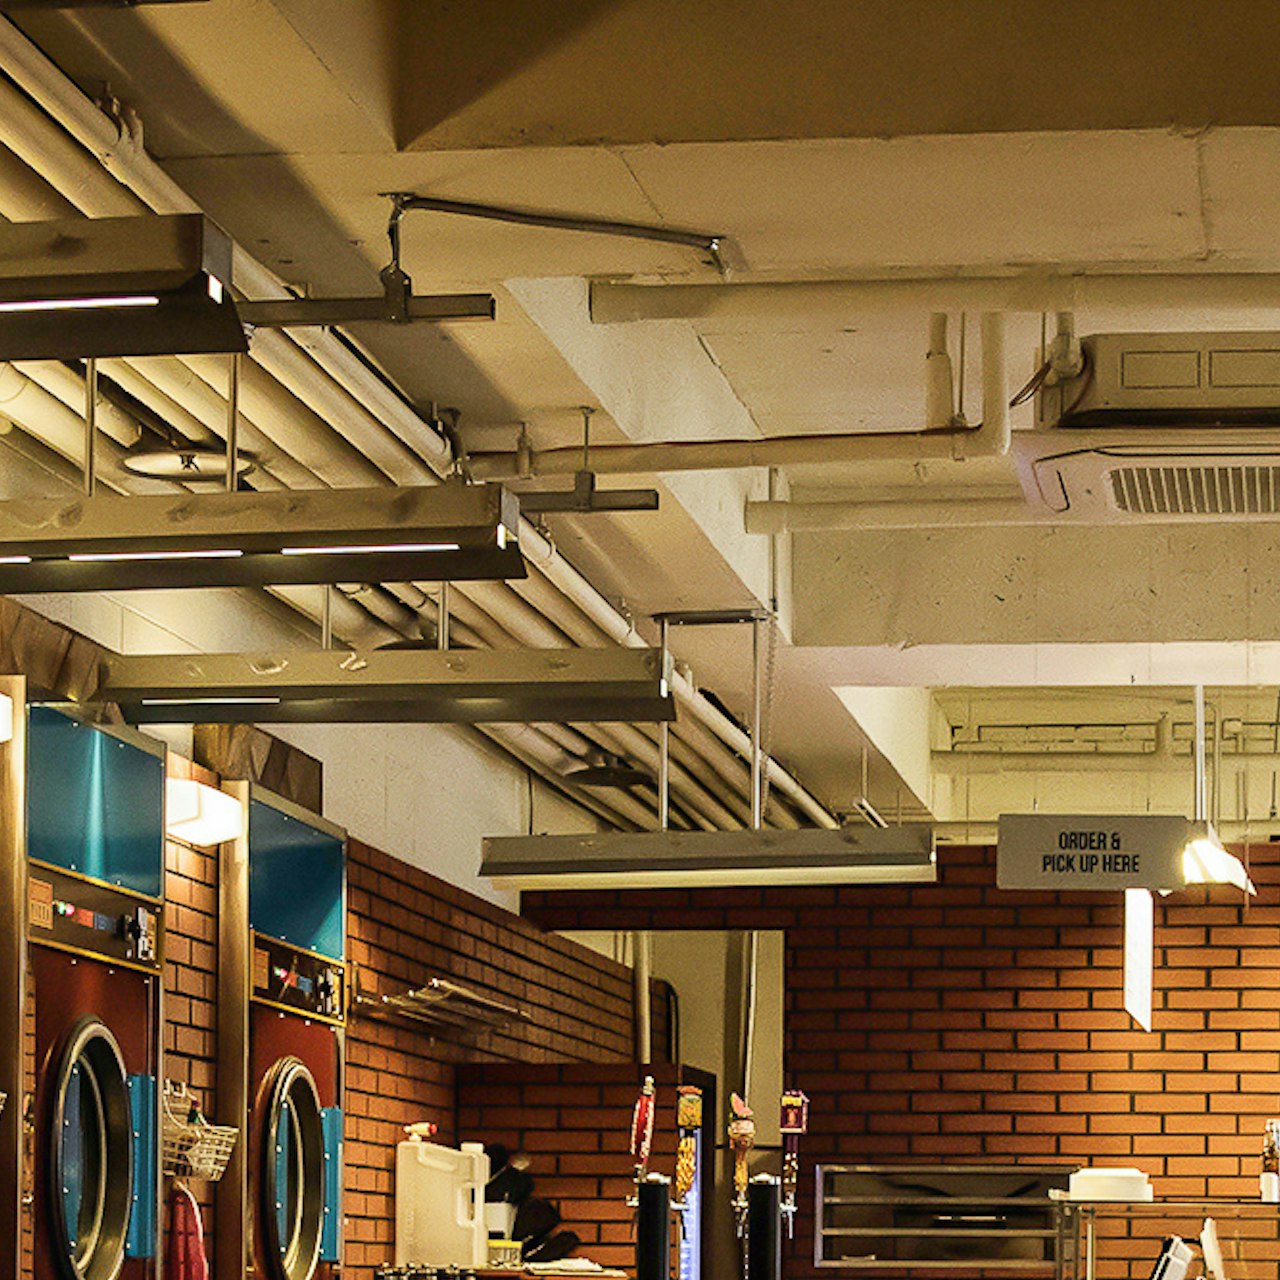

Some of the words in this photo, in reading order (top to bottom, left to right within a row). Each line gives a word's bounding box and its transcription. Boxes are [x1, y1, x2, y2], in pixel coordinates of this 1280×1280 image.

[1059, 832, 1107, 850] ORDER
[1111, 832, 1120, 850] &
[1042, 854, 1075, 872] PICK
[1080, 854, 1098, 872] UP
[1102, 854, 1140, 872] HERE
